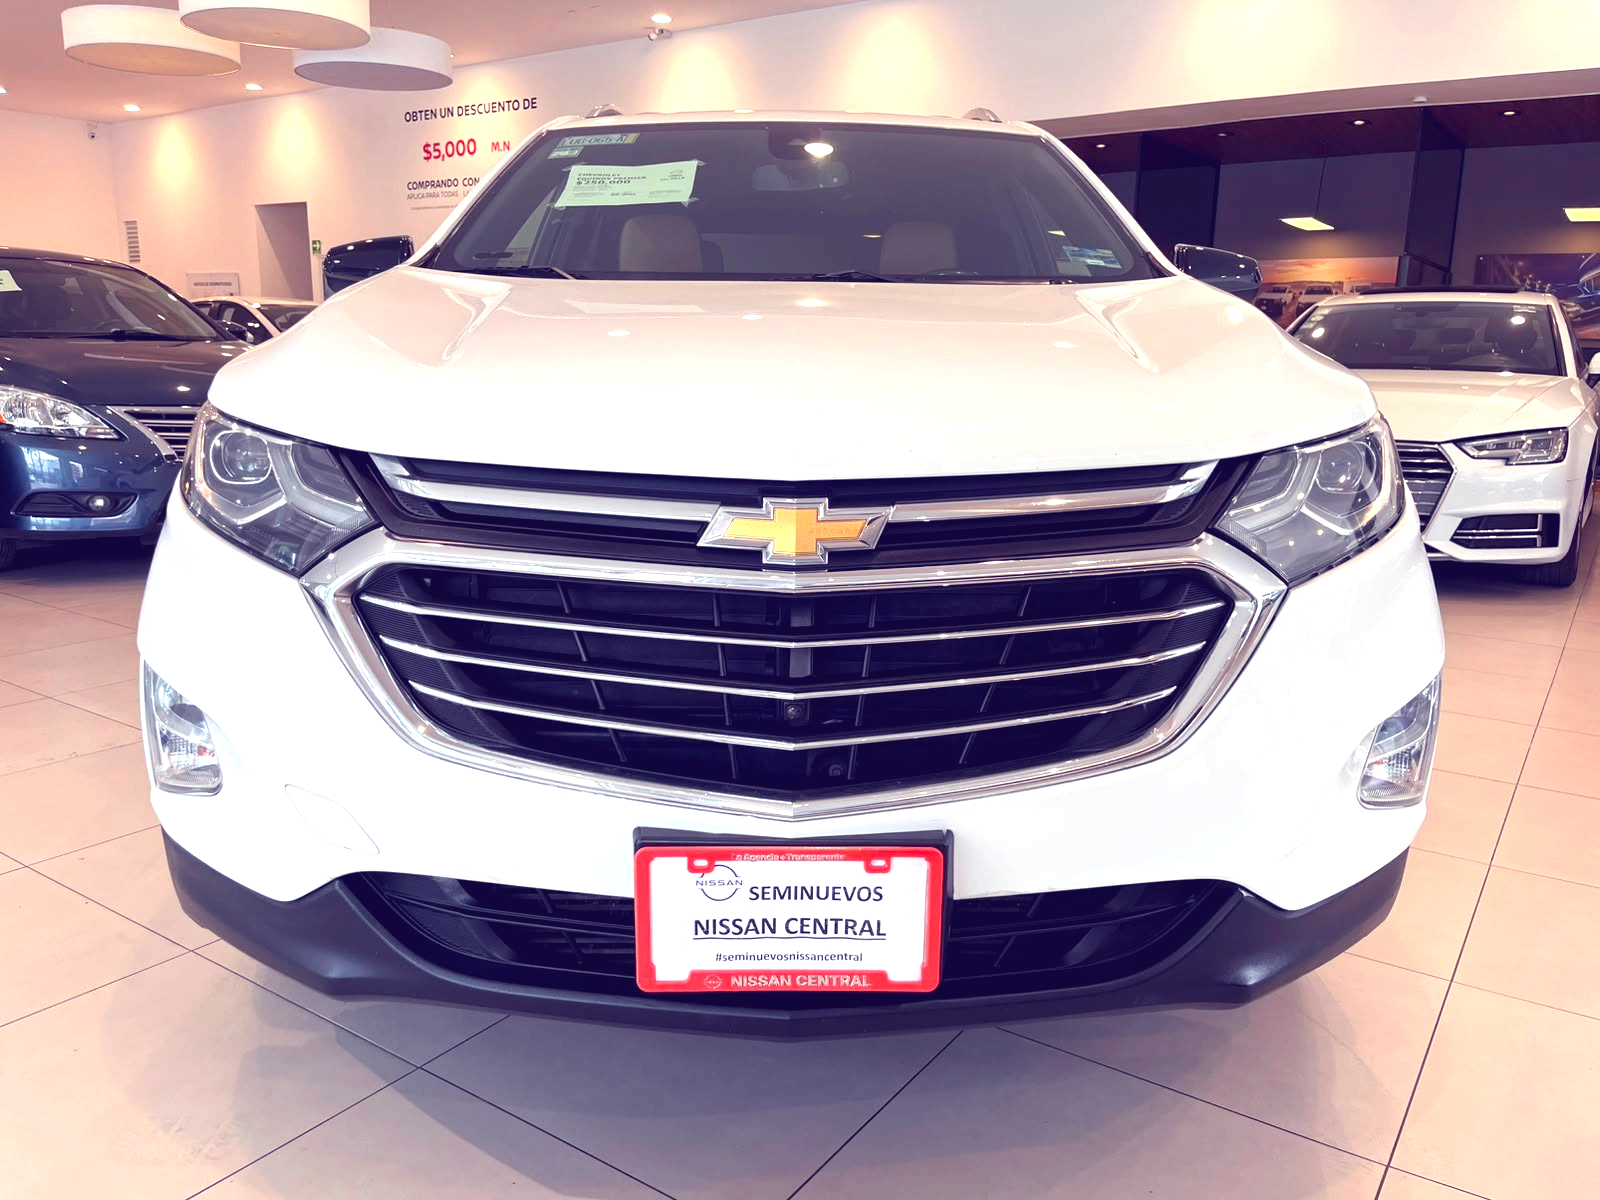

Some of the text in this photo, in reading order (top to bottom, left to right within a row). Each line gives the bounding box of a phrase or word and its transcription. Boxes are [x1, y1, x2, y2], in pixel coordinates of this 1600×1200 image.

[404, 97, 537, 123] OBTEN UN DESCUENTO DE
[422, 138, 477, 163] $5,000
[407, 176, 480, 191] COMPRANDO CON
[426, 191, 440, 199] PARA
[441, 190, 458, 198] TODAS
[749, 885, 883, 902] SEMINUEVOS
[693, 917, 887, 937] NISSAN CENTRAL
[715, 951, 863, 962] #seminuevosnissancentral
[730, 975, 872, 988] NISSAN CENTRAL
